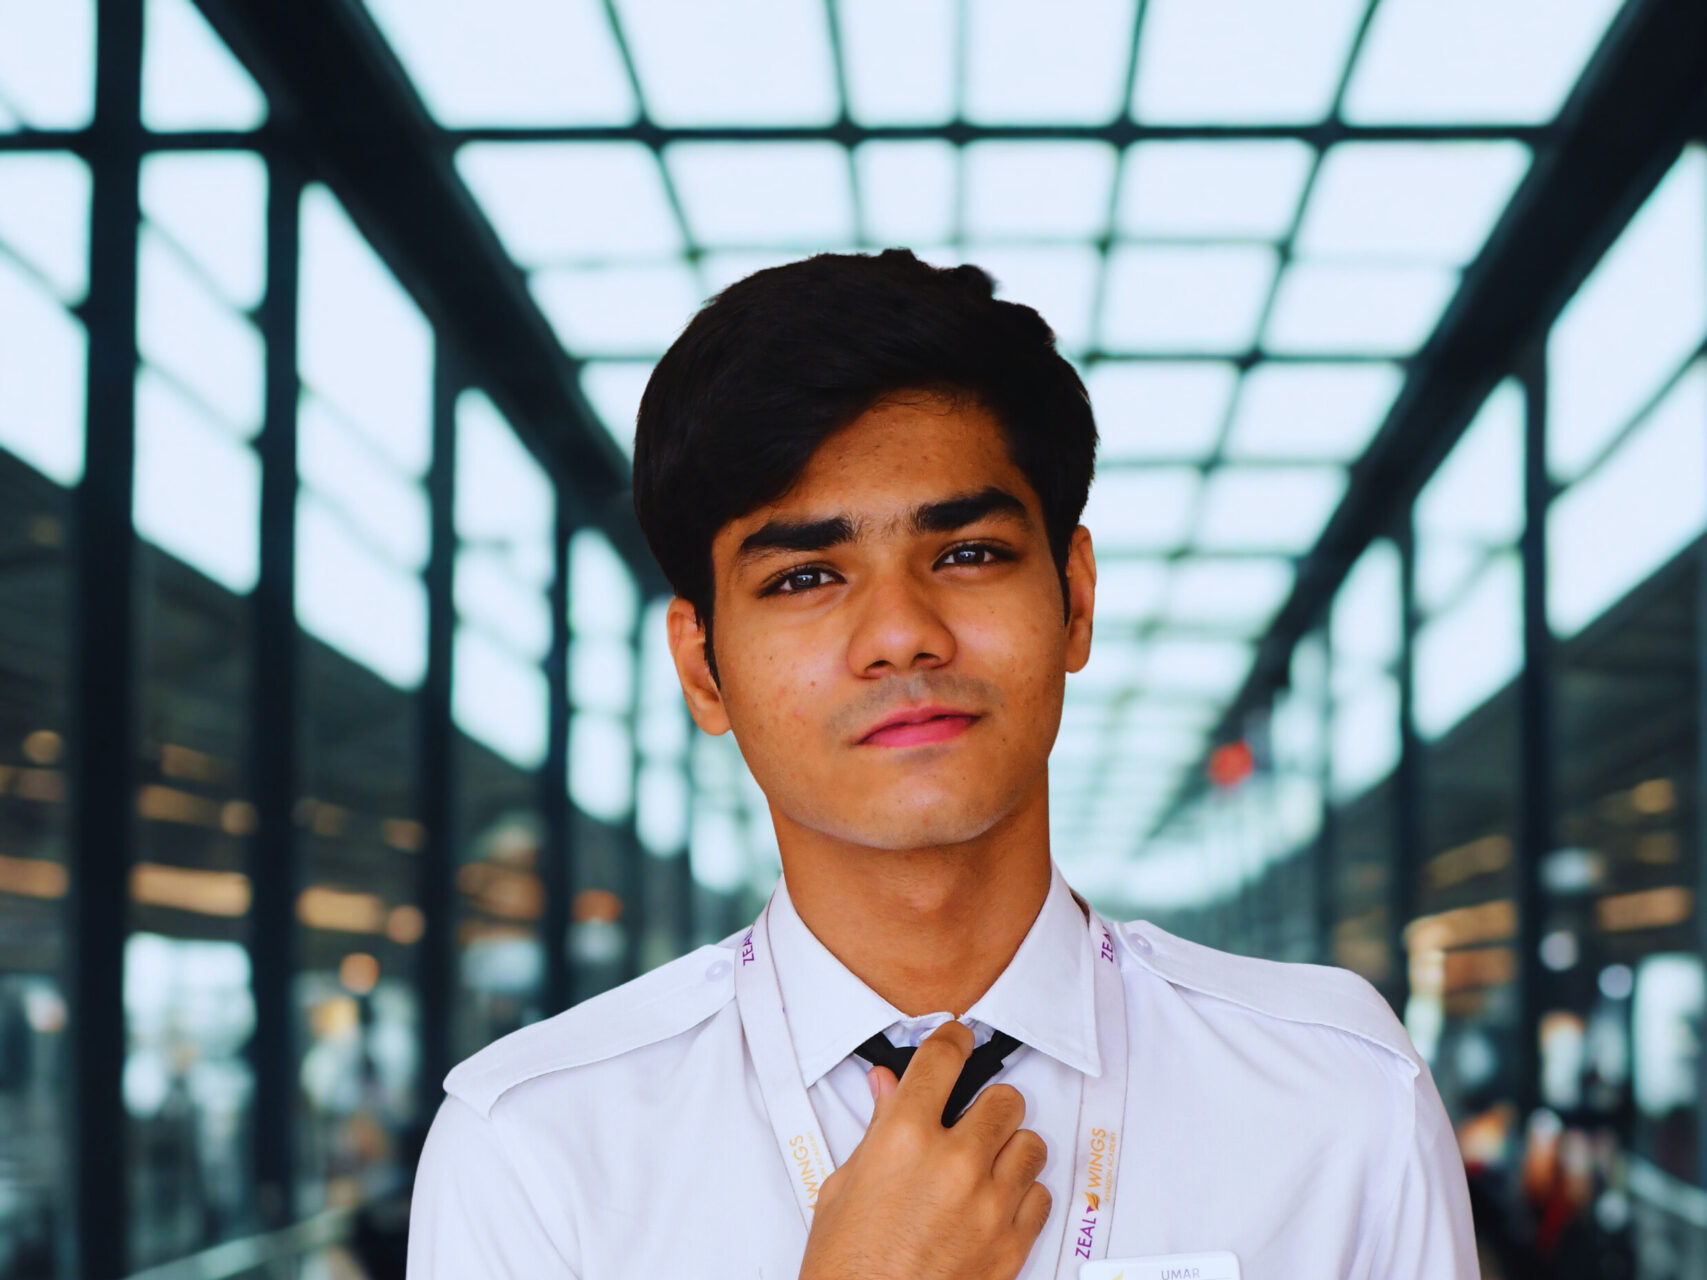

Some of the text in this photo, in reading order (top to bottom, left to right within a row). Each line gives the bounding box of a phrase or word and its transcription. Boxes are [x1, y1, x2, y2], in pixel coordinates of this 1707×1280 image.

[789, 1133, 819, 1199] WINGS
[1075, 1127, 1107, 1260] ZEAL WINGS
[1160, 1268, 1201, 1280] UMAR
